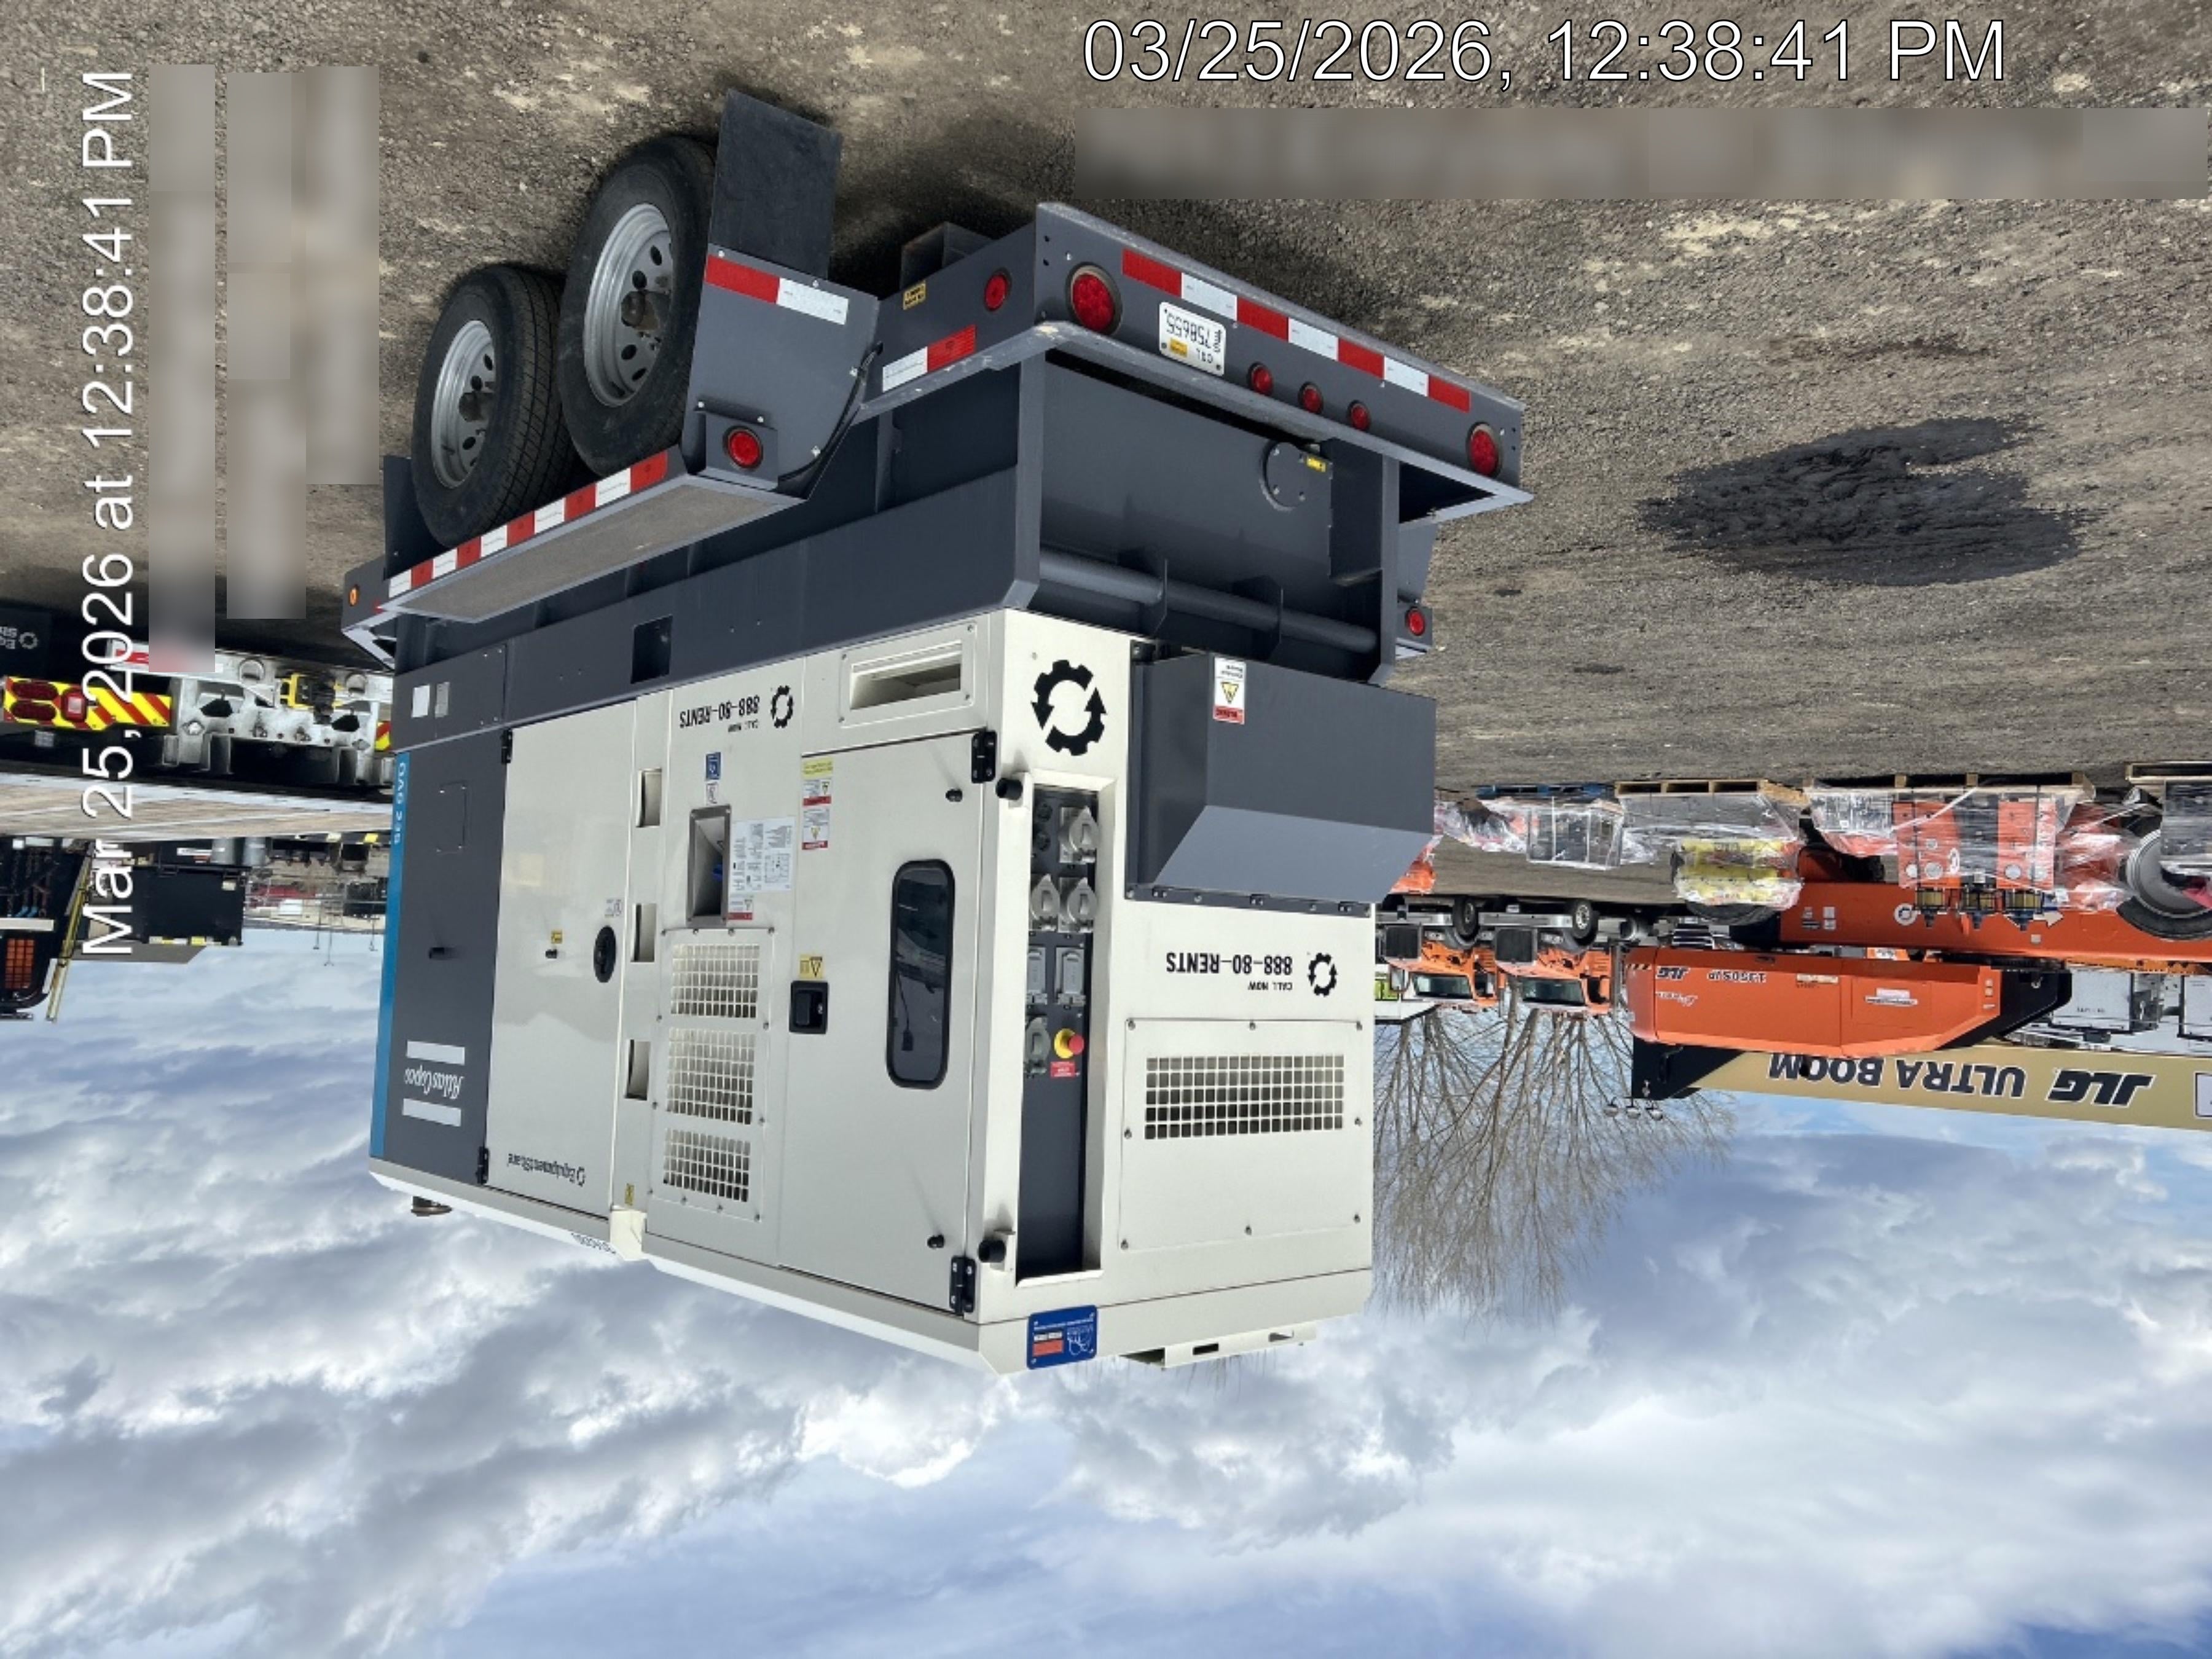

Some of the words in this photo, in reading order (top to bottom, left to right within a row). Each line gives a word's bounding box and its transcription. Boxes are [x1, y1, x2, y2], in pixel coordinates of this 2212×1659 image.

[679, 694, 761, 729] 888-80-RENTS
[1166, 951, 1293, 976] 888-80-RENTS
[1655, 966, 1691, 981] JLG
[1247, 981, 1269, 991] NOW
[1272, 981, 1293, 991] CALL
[1769, 1053, 1884, 1089] BOOM
[1896, 1059, 2025, 1098] ULTRA
[2047, 1070, 2154, 1107] JLG
